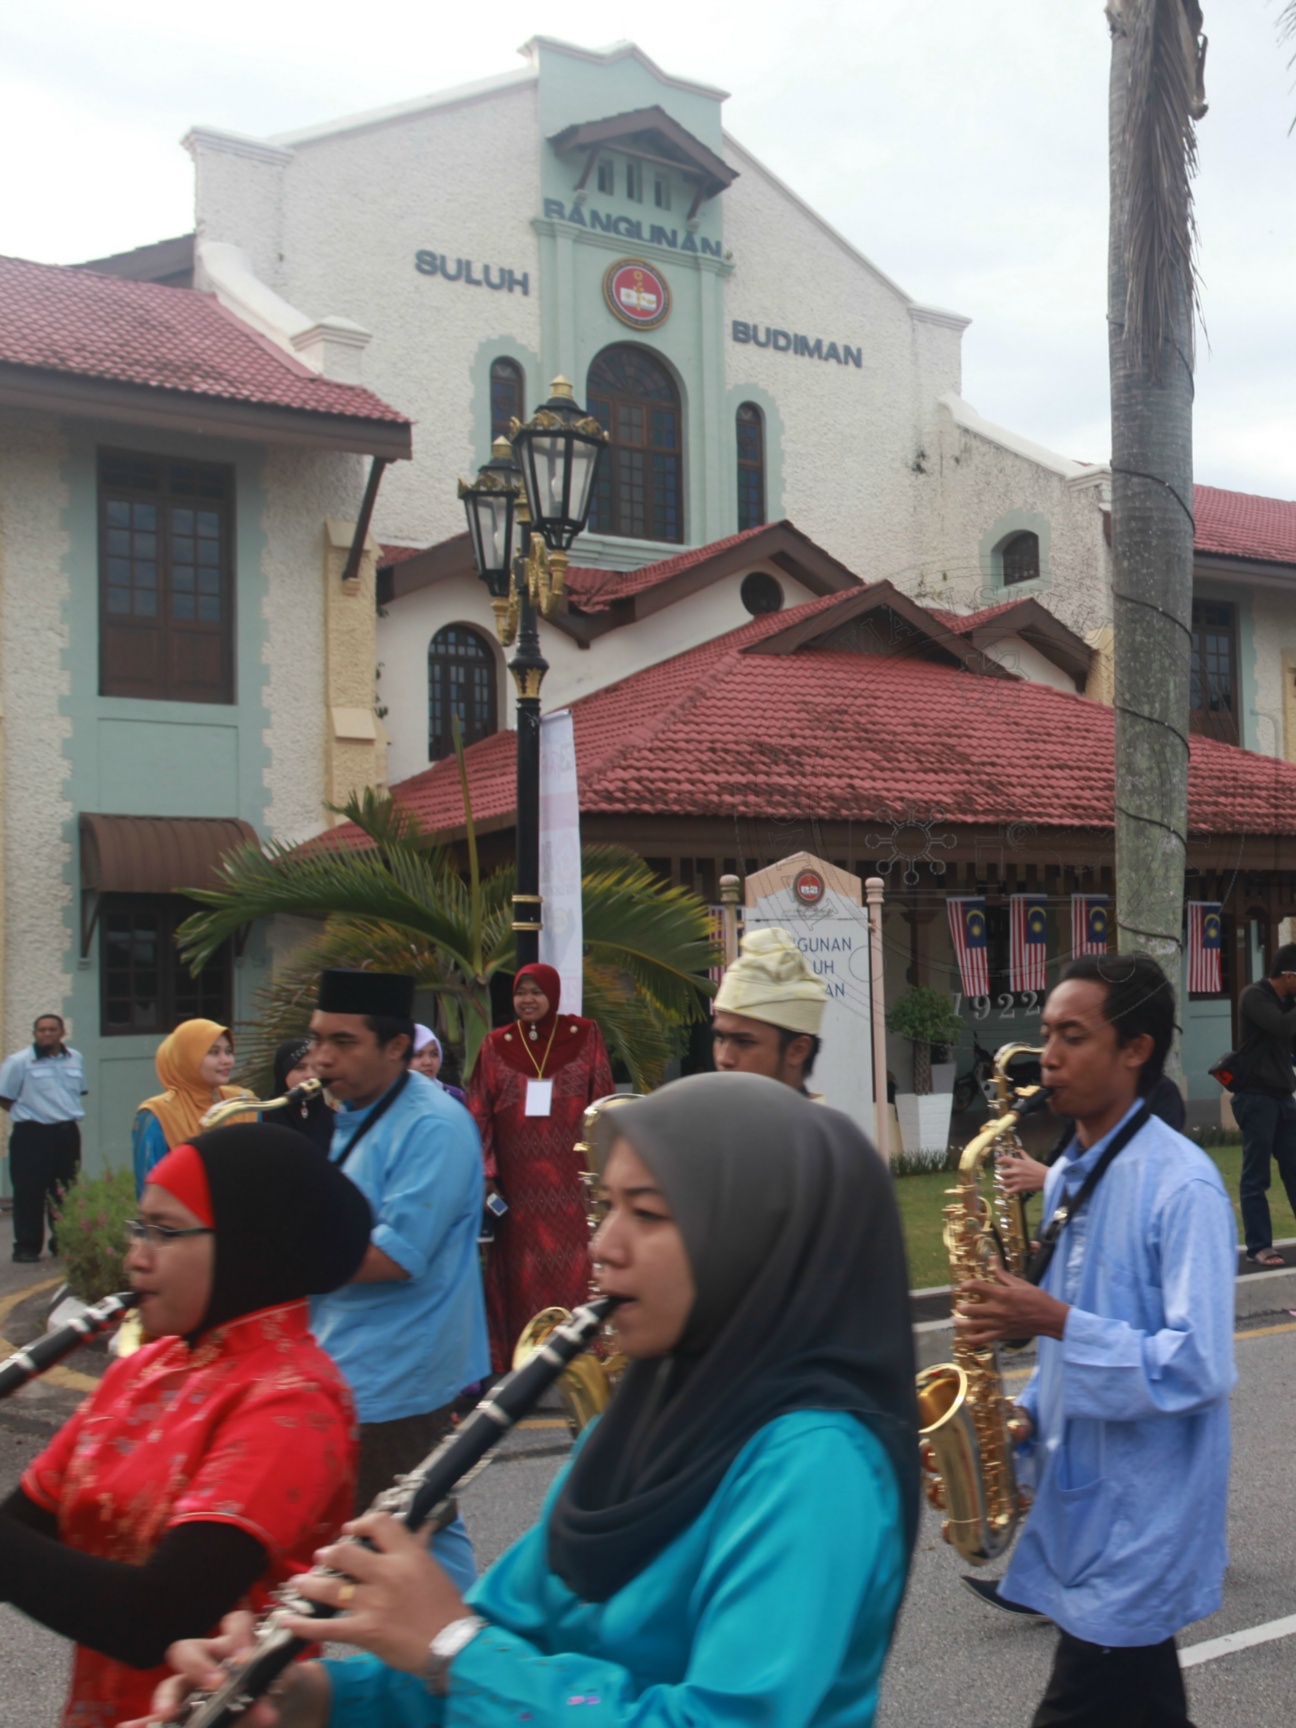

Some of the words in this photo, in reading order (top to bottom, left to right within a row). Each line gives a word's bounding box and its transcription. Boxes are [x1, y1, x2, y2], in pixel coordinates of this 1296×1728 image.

[543, 197, 722, 258] BANGUNAN
[414, 248, 530, 297] SULUH
[731, 318, 863, 369] BUDIMAN
